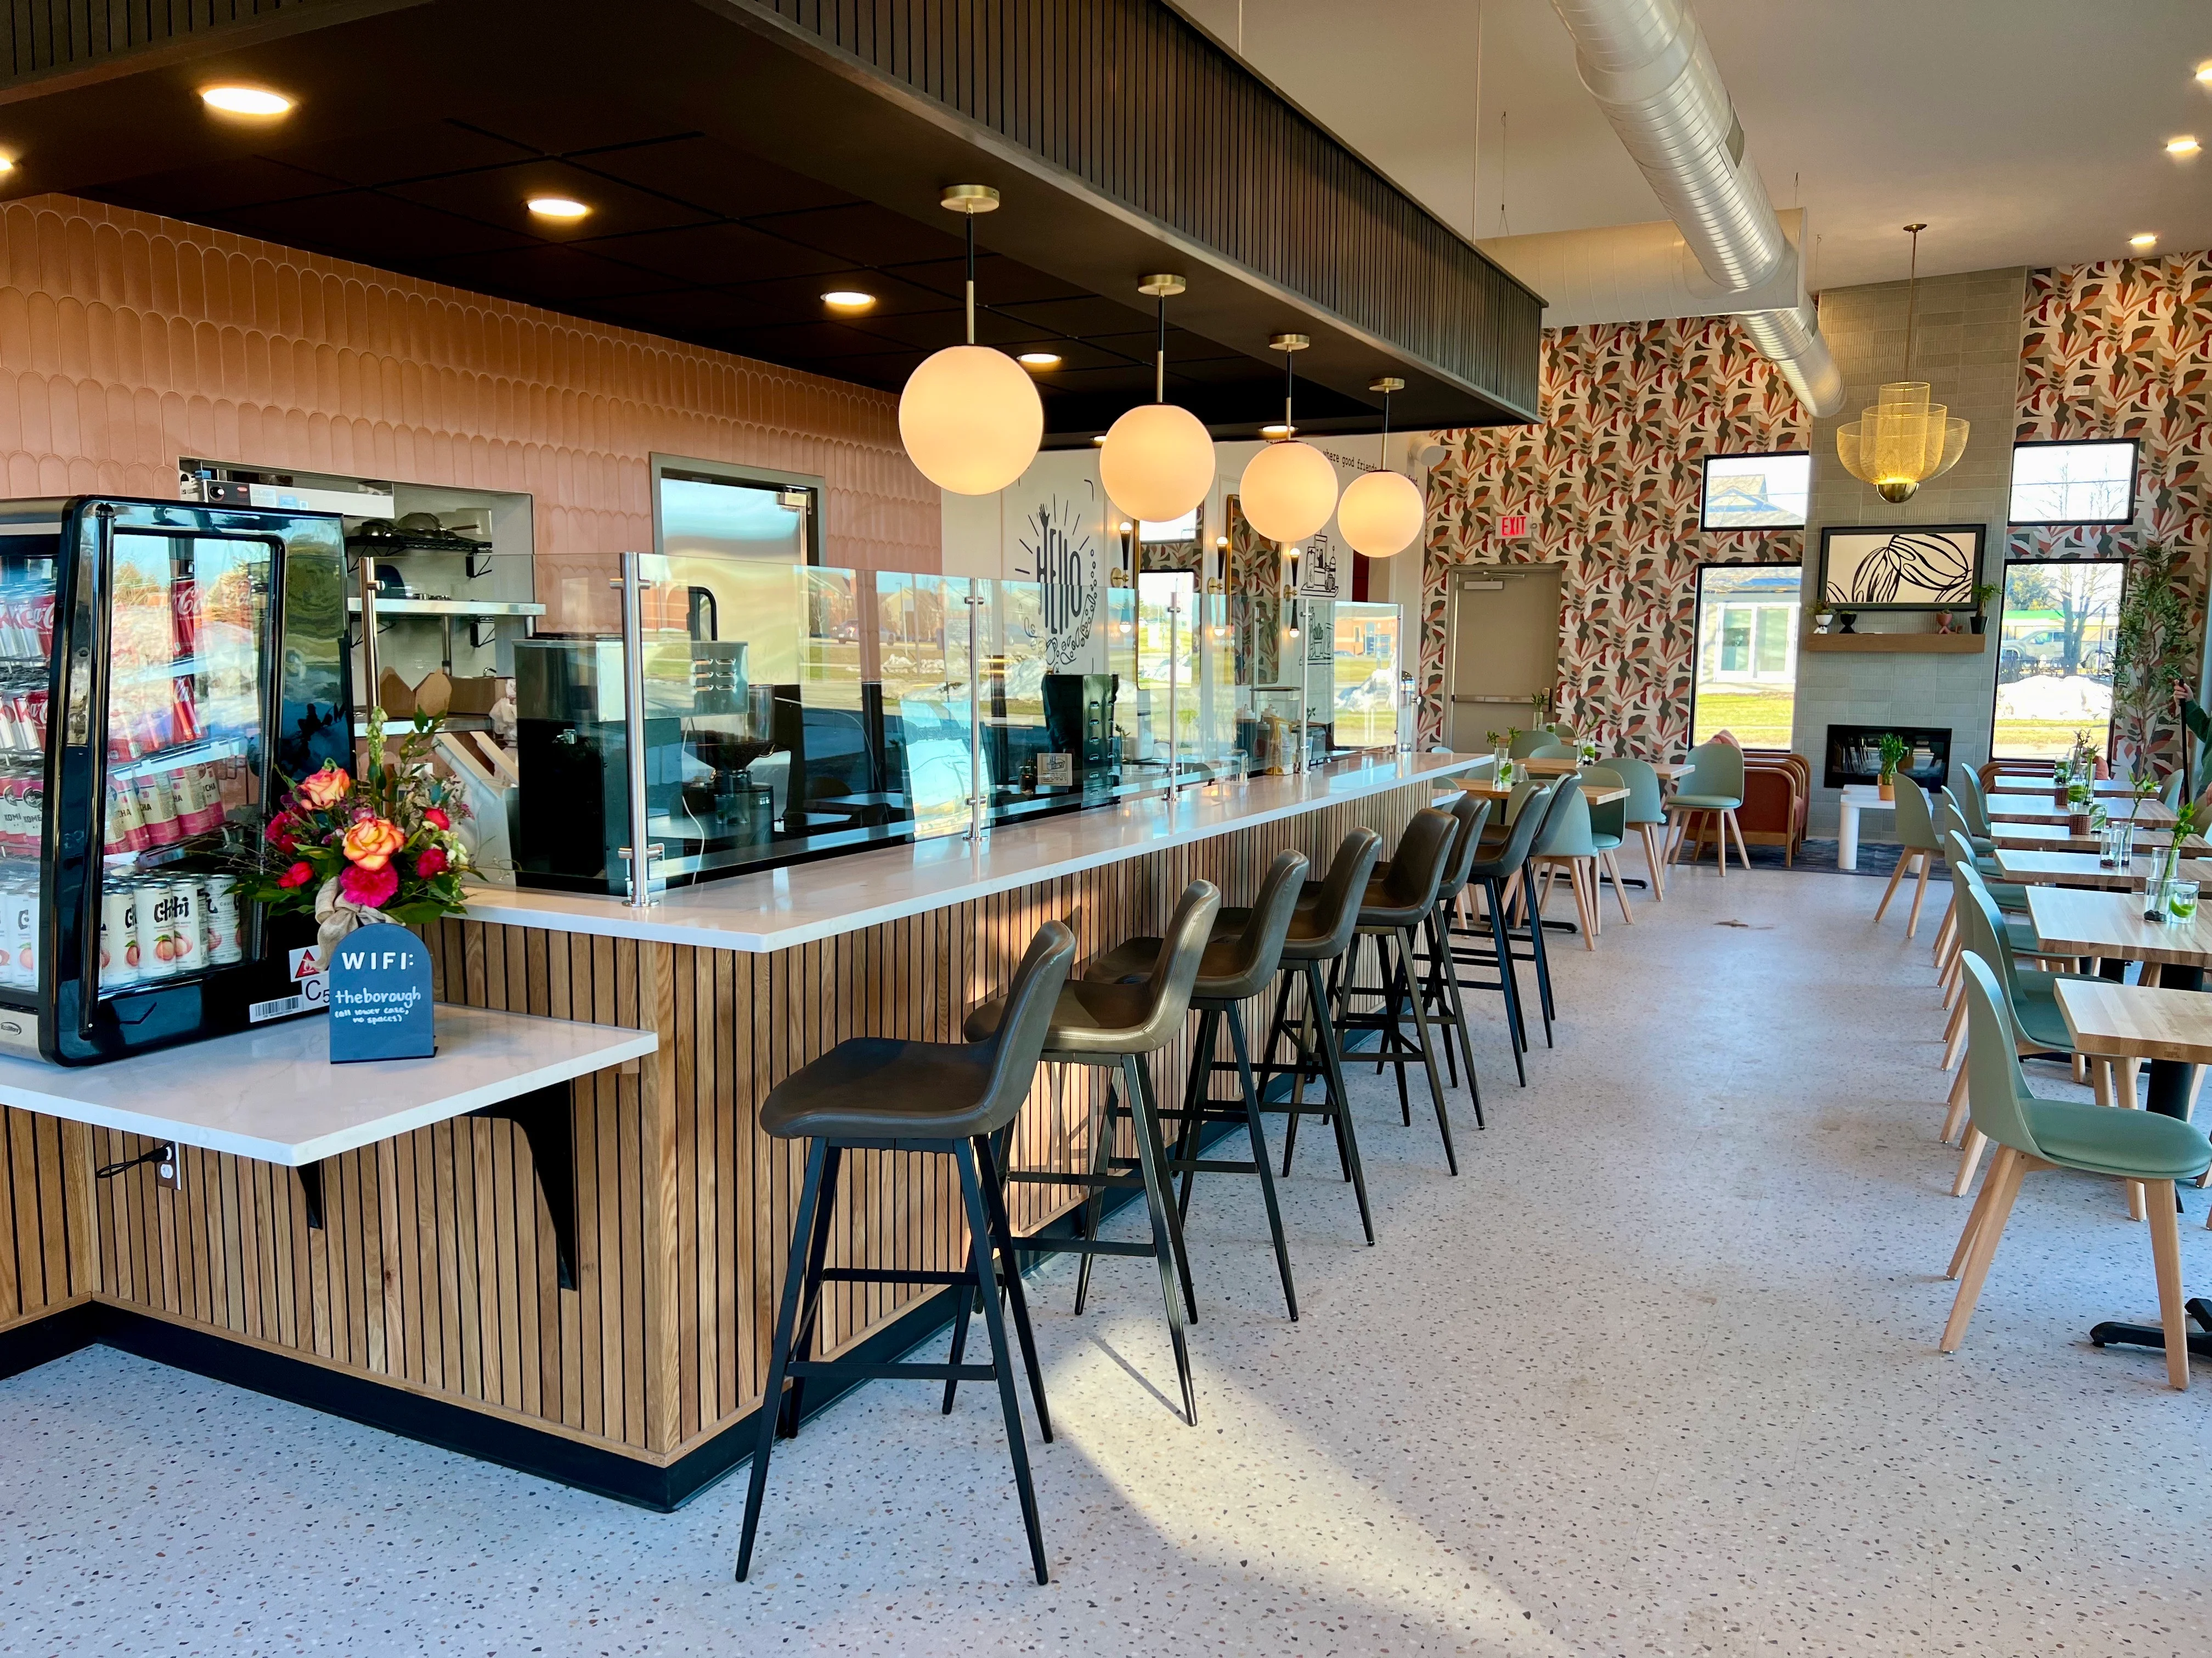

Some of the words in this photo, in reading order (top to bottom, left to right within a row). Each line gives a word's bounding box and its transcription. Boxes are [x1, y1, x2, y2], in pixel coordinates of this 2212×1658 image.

[1342, 456, 1355, 468] good
[1502, 516, 1526, 536] EXIT
[1036, 503, 1082, 635] HELLO
[341, 952, 414, 970] WIFI:
[335, 986, 421, 1009] theborough
